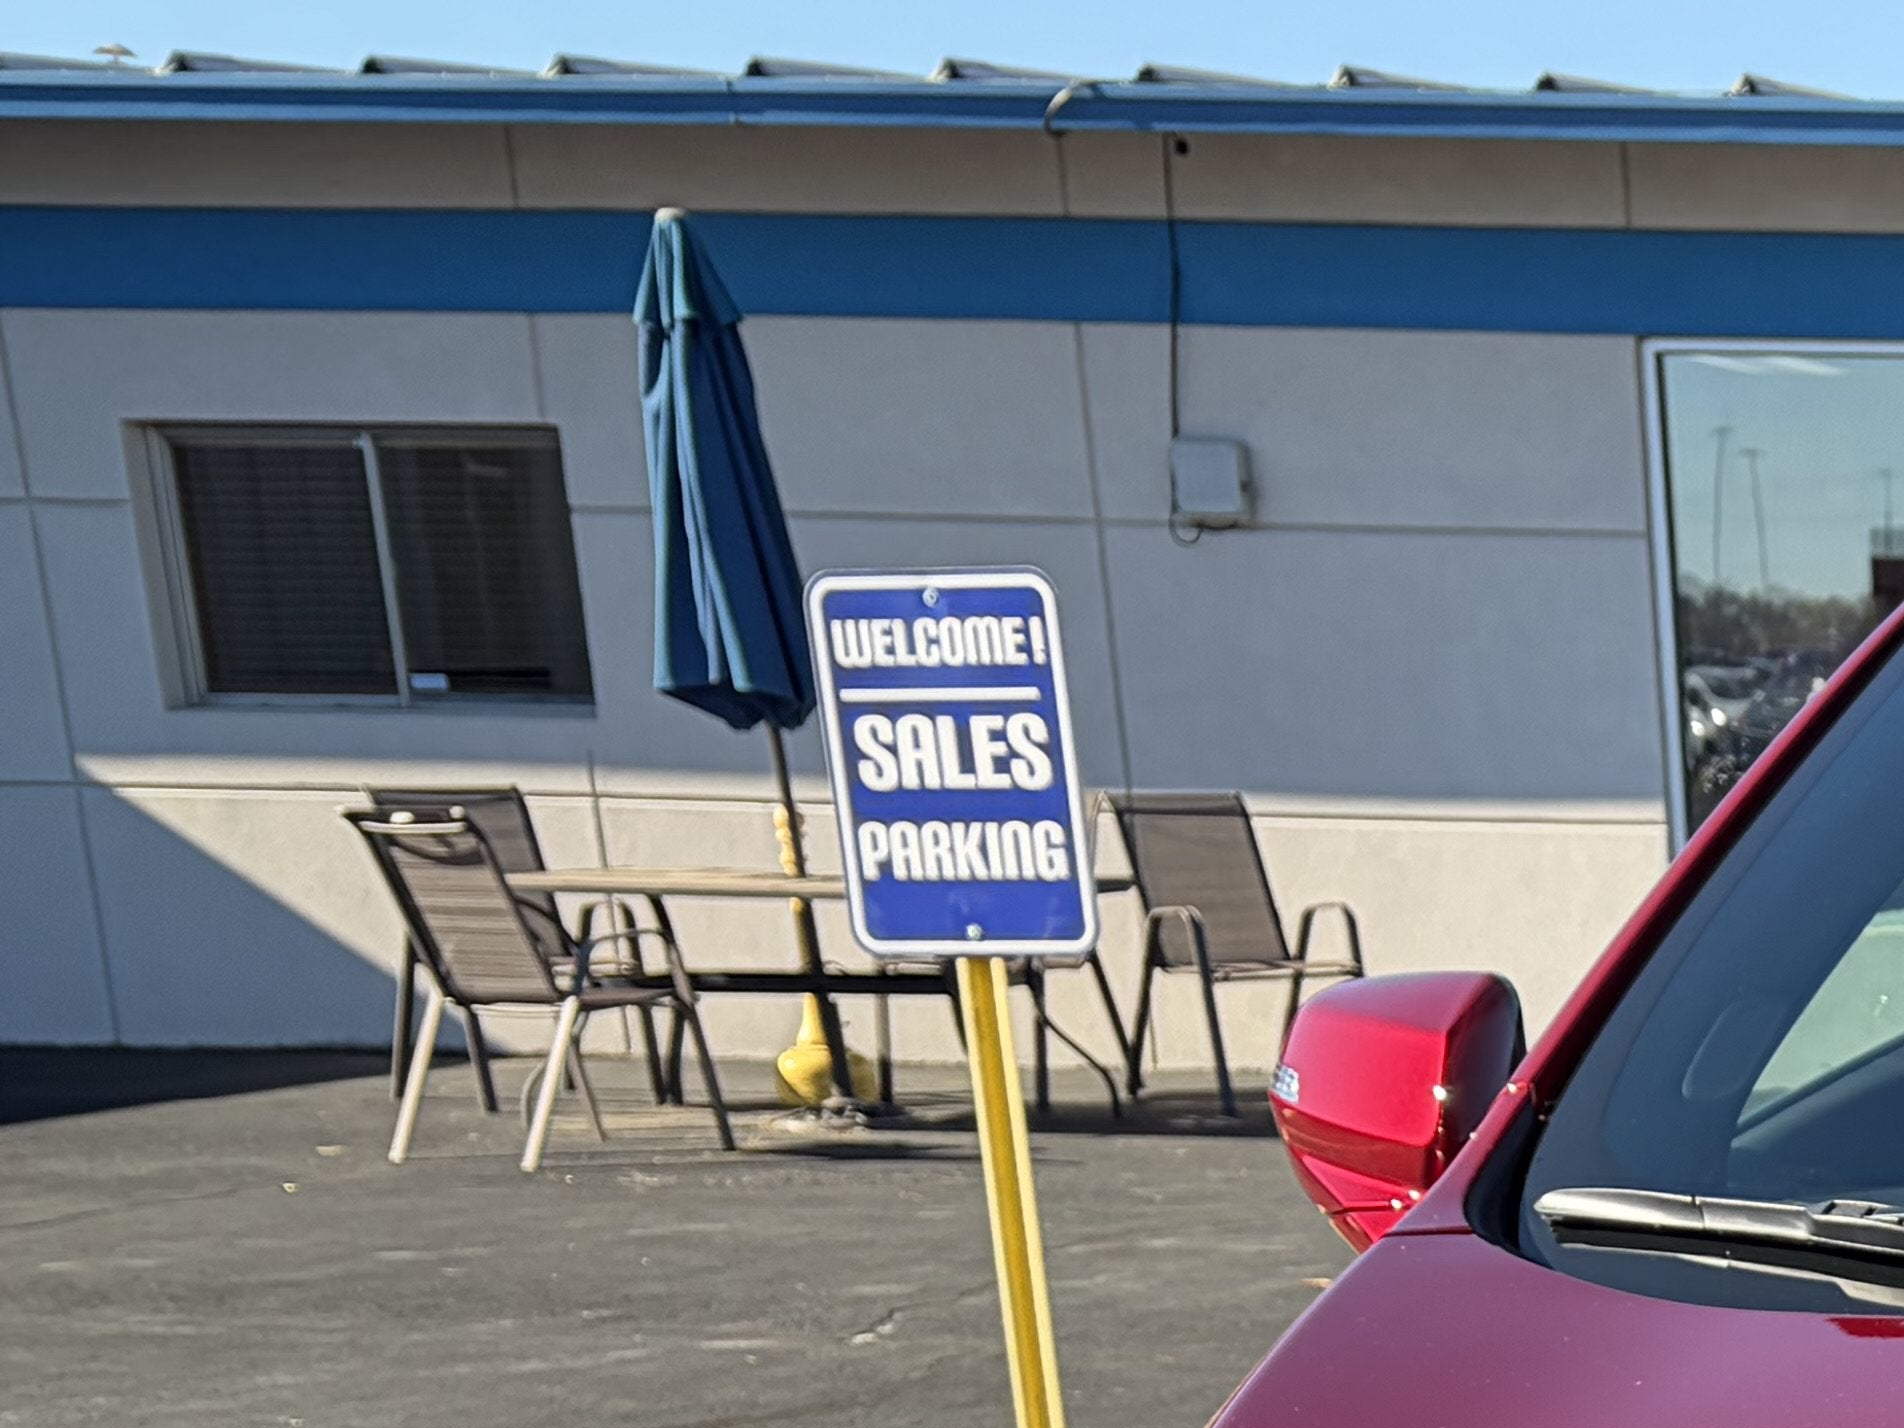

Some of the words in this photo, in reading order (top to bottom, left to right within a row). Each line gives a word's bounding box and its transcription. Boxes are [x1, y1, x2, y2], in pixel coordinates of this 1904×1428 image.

[830, 616, 1048, 668] WELCOME!
[853, 713, 1053, 791] SALES
[858, 820, 1070, 882] PARKING
